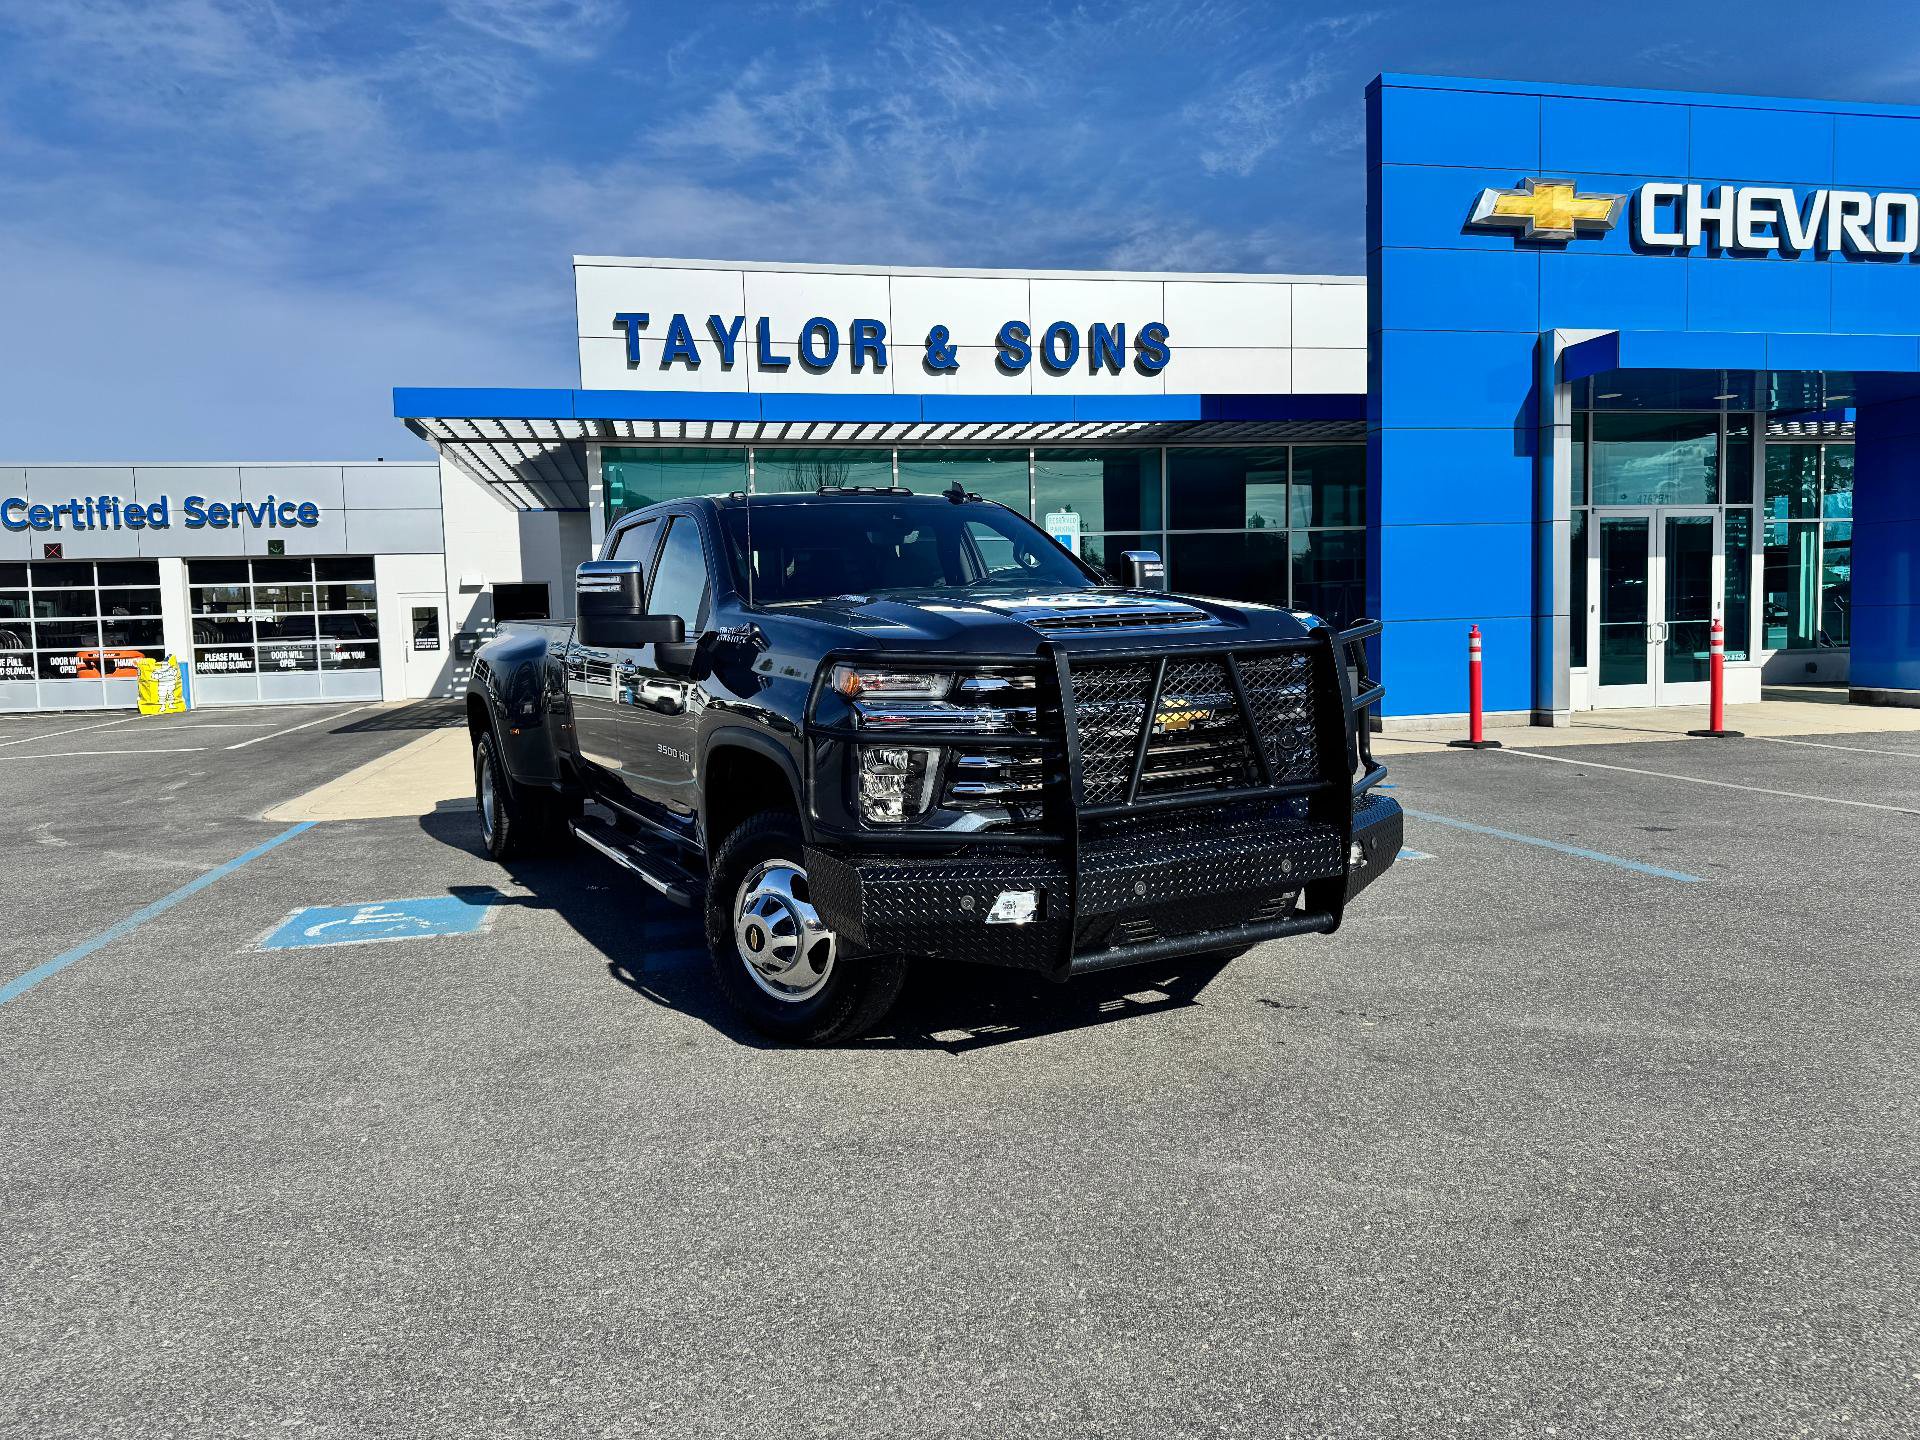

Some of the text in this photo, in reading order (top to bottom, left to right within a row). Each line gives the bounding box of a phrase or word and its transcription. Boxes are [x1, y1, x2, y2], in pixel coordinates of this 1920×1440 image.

[1640, 182, 1919, 254] CHEVRO
[613, 312, 1171, 374] TAYLOR & SONS
[0, 495, 320, 530] Certified Service
[205, 653, 228, 662] PLEASE
[271, 651, 288, 659] DOOR
[330, 652, 350, 660] THANK
[50, 657, 85, 665] DOOR WILL
[197, 660, 252, 670] FORWARD SLOWLY
[280, 659, 296, 667] OPEN
[60, 665, 76, 673] OPEN
[657, 743, 690, 762] 3500 HD
